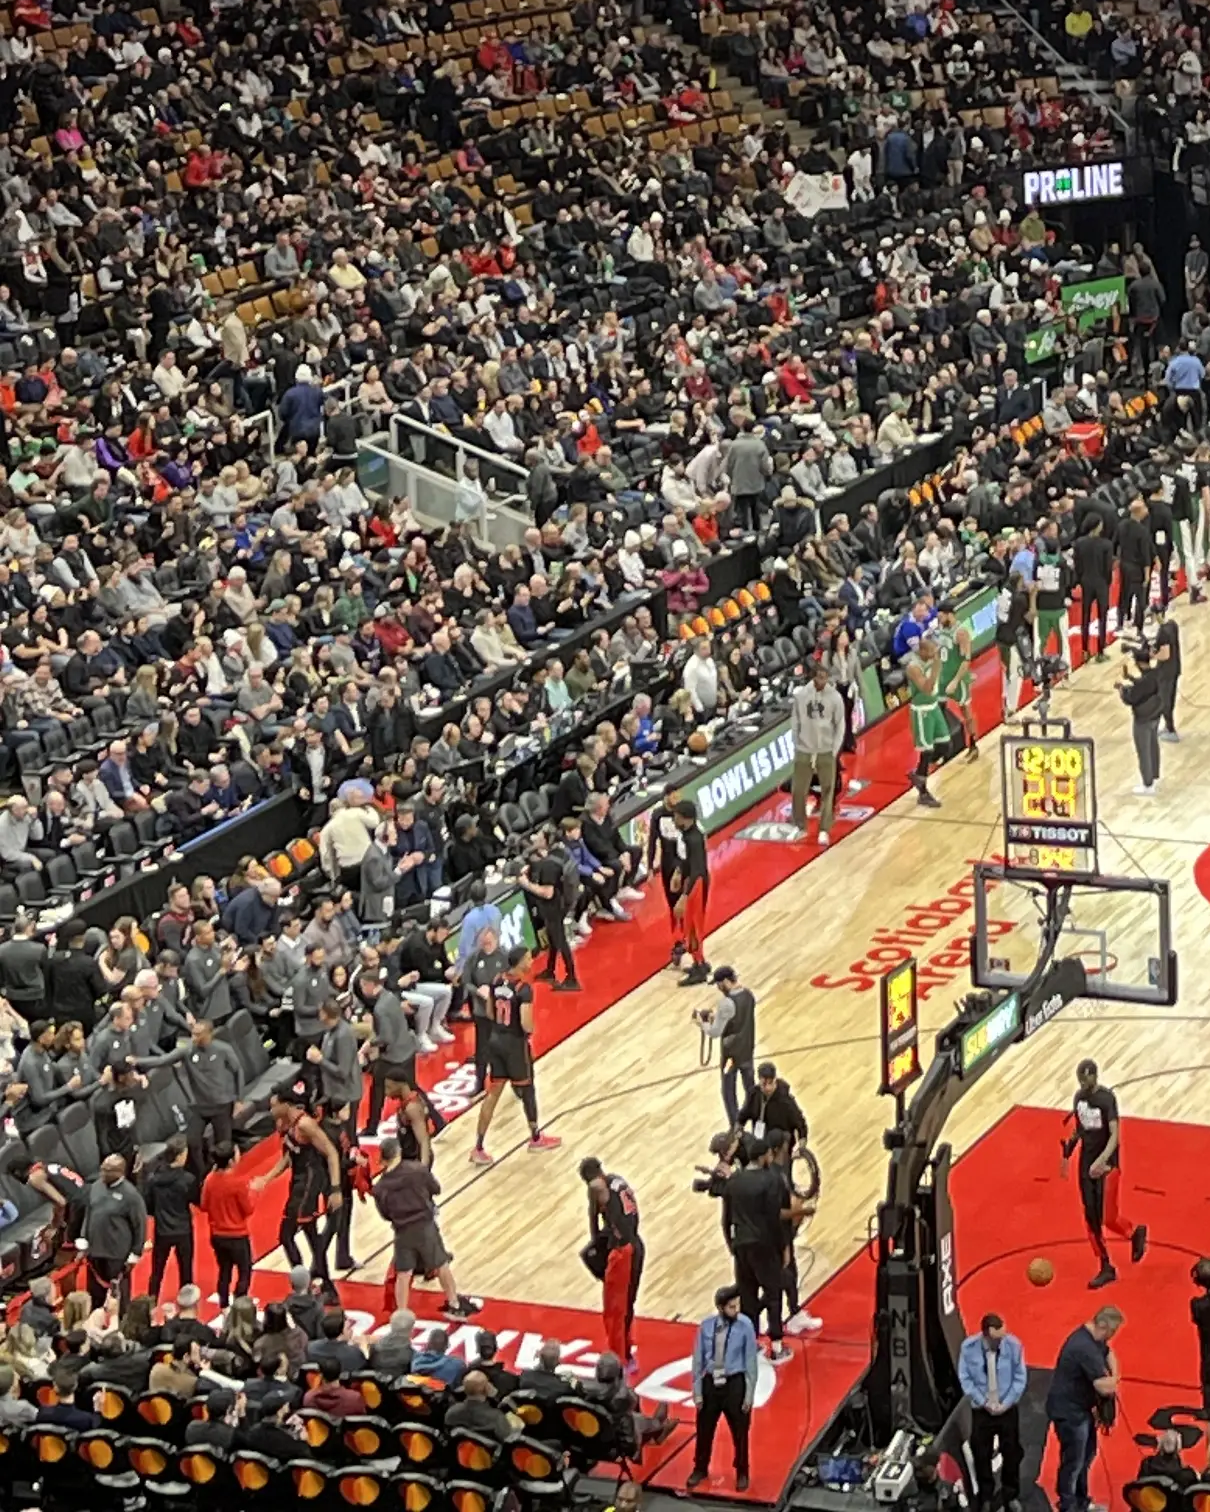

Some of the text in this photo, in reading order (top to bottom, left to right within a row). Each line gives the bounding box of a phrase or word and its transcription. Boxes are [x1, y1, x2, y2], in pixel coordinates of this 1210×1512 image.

[1024, 162, 1124, 206] PROLINE
[697, 761, 754, 819] BOWL
[750, 747, 772, 784] IS
[1022, 774, 1077, 818] 24
[1033, 826, 1090, 842] TISSOT
[891, 1309, 912, 1387] NBA
